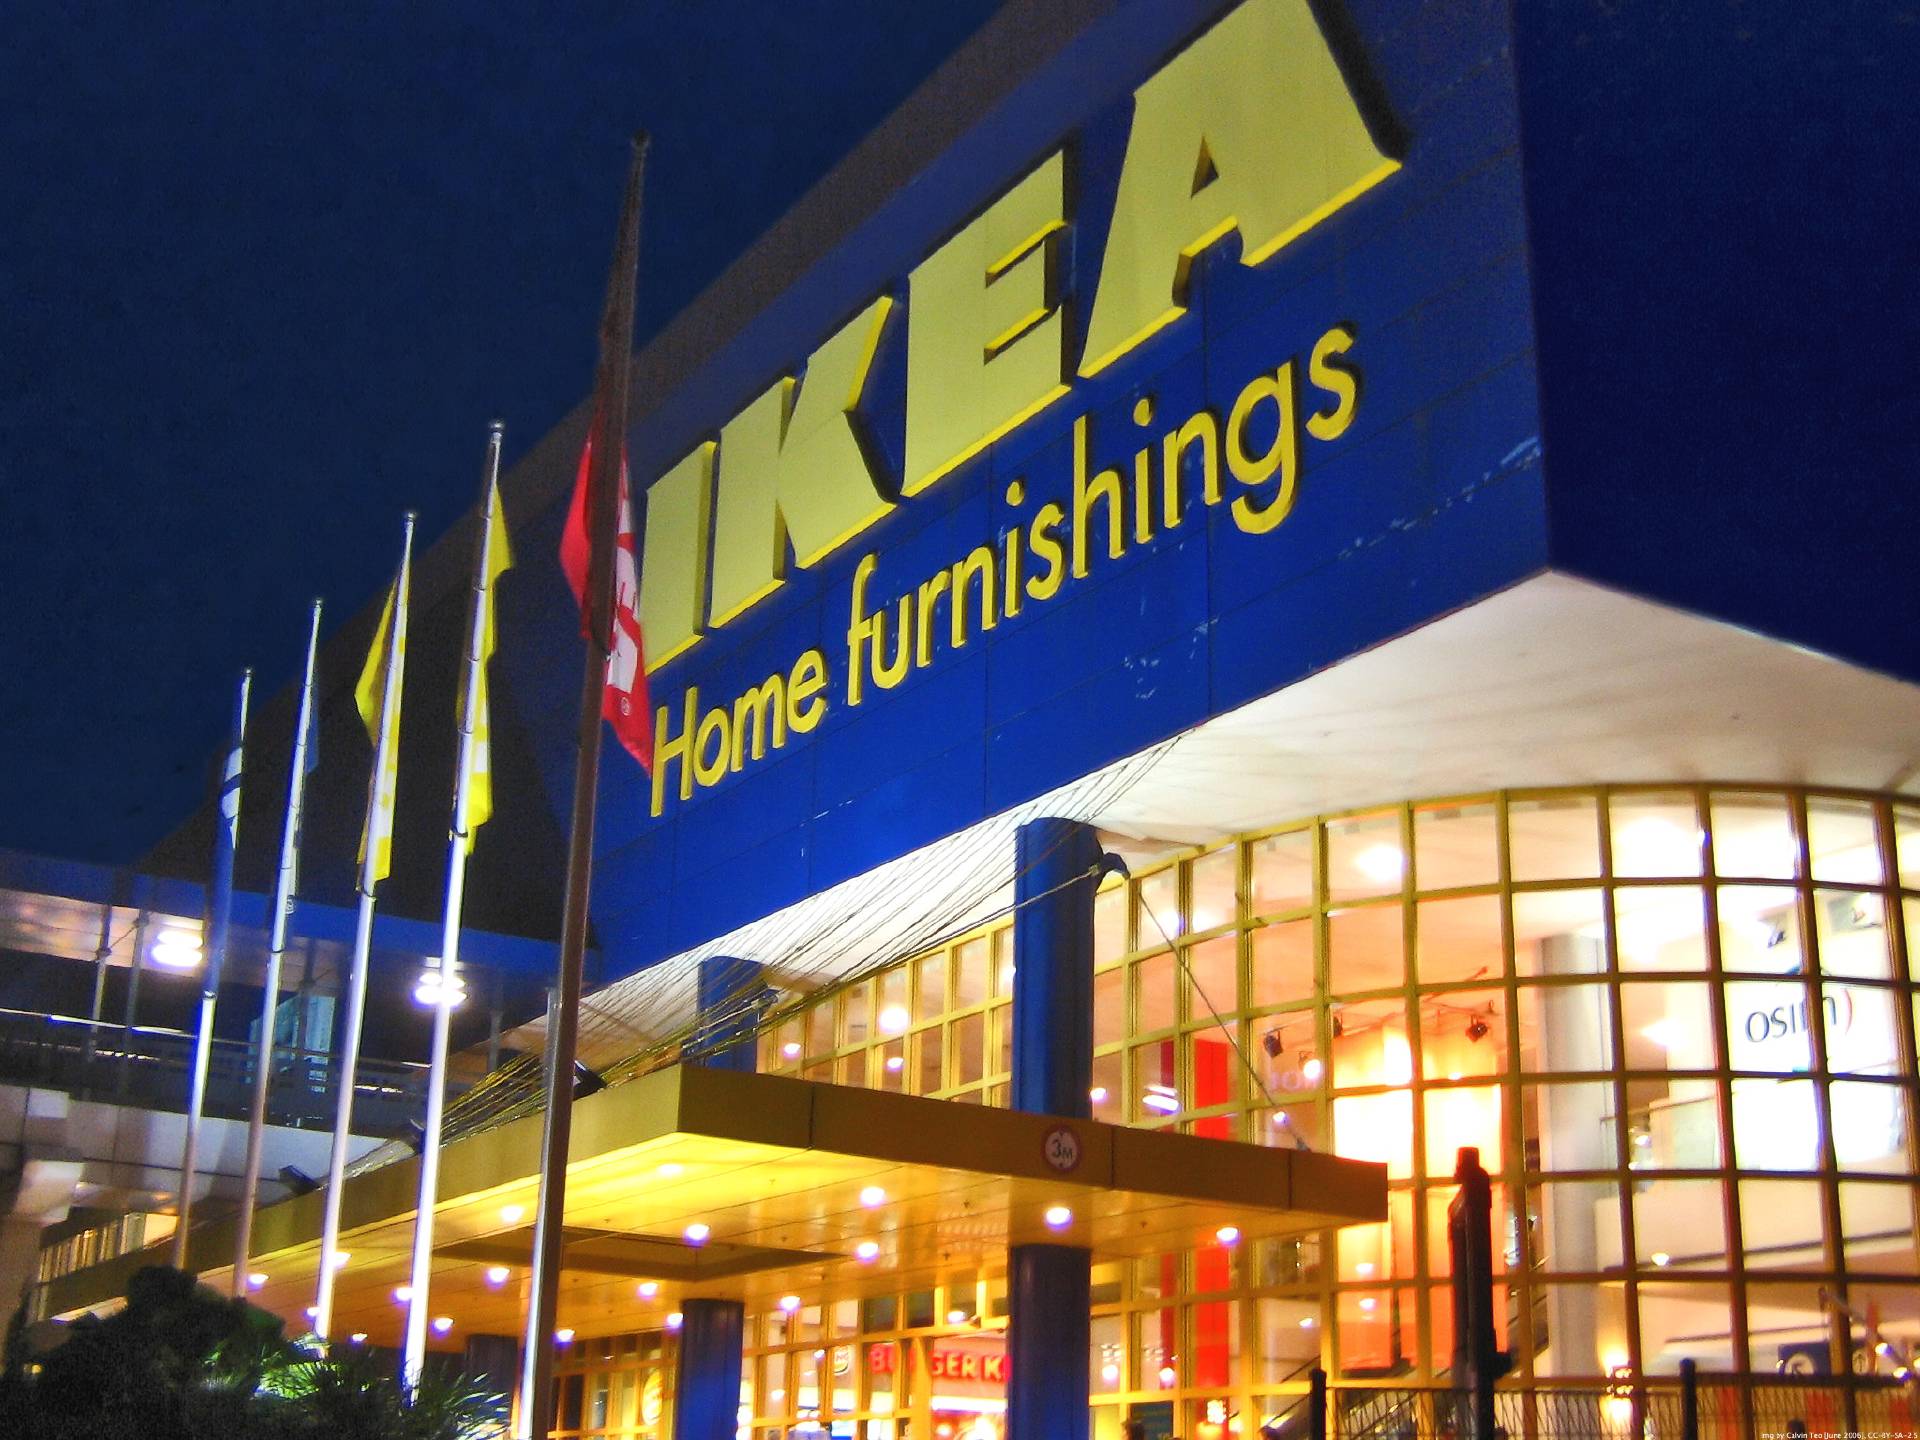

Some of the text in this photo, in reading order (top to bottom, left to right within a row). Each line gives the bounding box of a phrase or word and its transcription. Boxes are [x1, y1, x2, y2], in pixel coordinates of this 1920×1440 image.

[641, 0, 1402, 673] IKEA
[650, 650, 828, 817] Home
[847, 328, 1357, 706] furnishings
